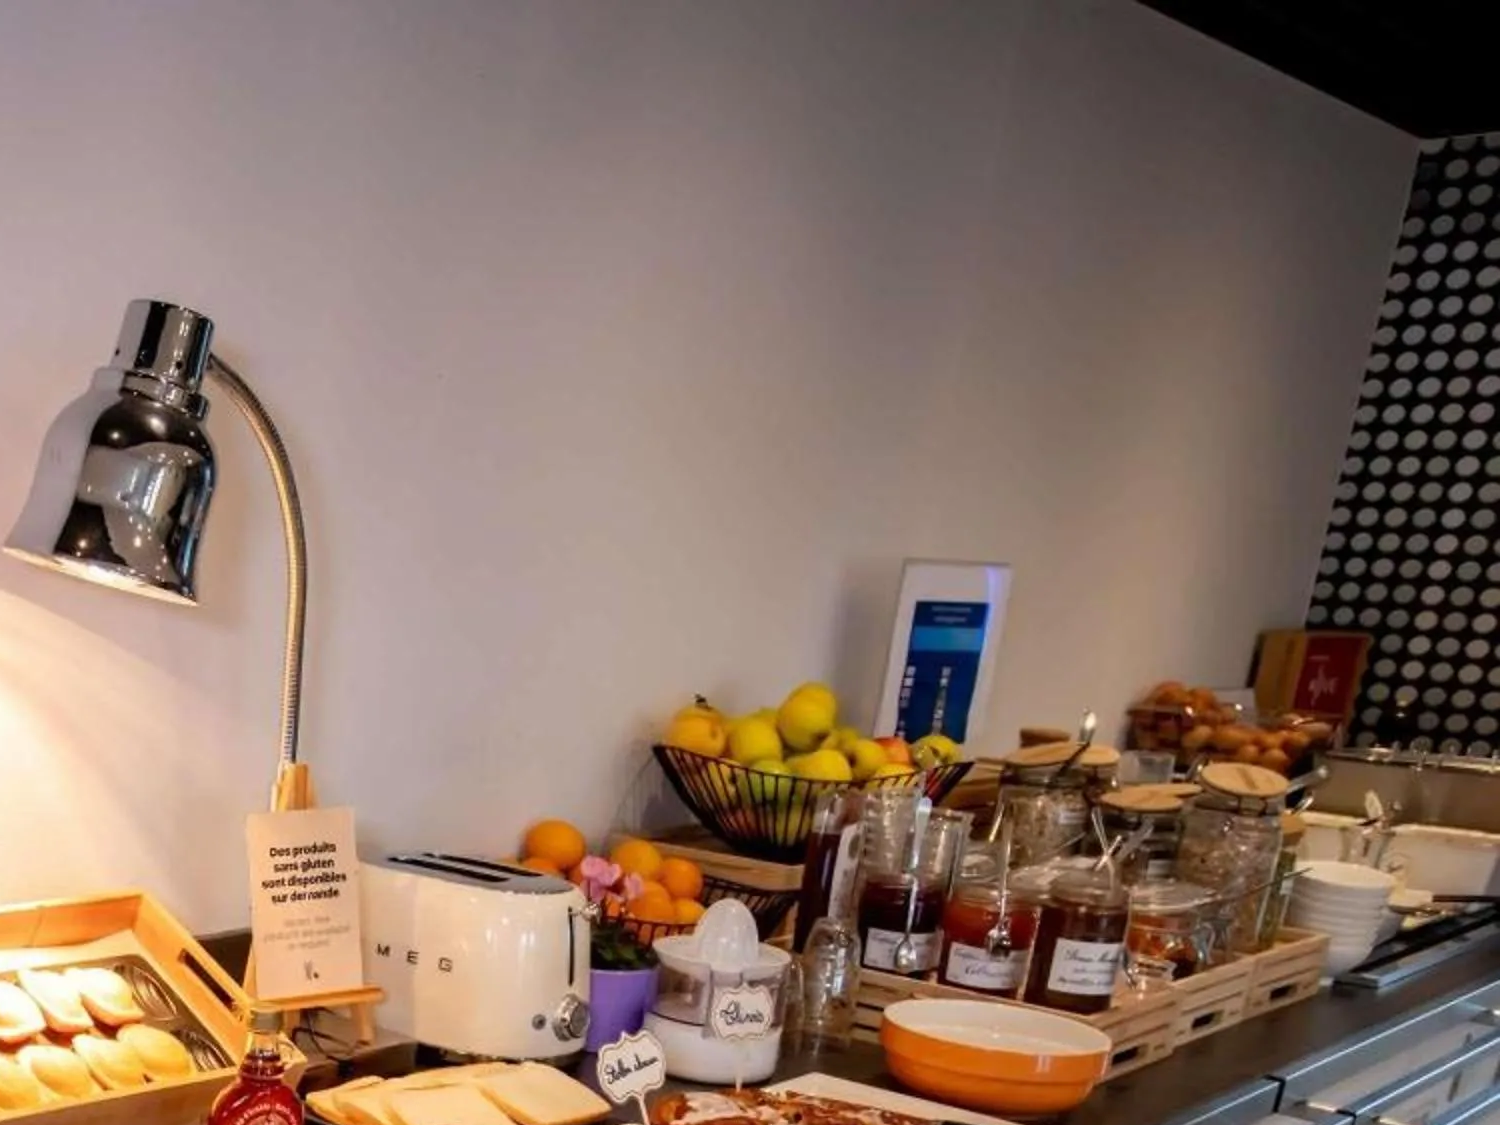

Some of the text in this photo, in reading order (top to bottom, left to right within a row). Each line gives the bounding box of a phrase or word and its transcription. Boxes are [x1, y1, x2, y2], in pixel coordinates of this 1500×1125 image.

[269, 842, 337, 858] Des produits
[273, 858, 335, 873] sans gluten
[261, 871, 347, 890] sont disponibles
[271, 887, 340, 903] sur demande
[377, 943, 453, 973] MEG
